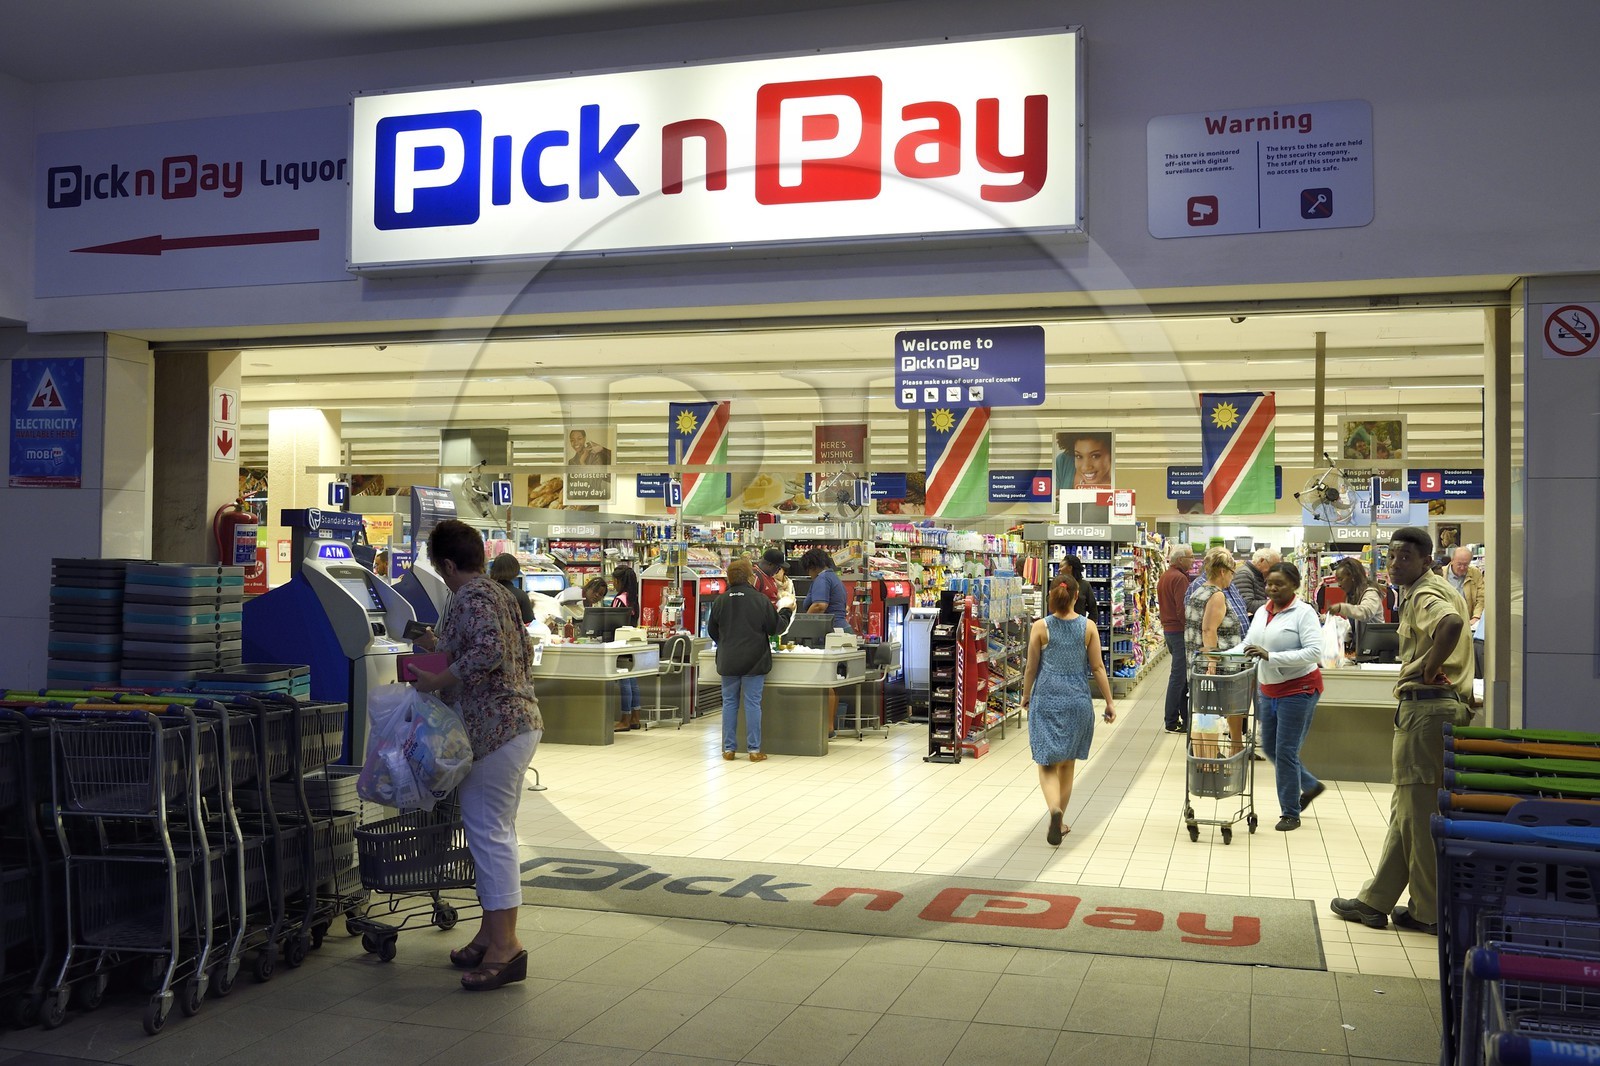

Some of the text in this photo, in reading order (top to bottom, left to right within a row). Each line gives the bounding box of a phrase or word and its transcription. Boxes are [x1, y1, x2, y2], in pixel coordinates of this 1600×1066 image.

[1205, 111, 1312, 135] Warning
[374, 75, 1048, 231] Pick n Pay
[1289, 151, 1316, 159] security
[1208, 157, 1228, 166] digital
[1165, 167, 1204, 175] surveillance
[48, 155, 346, 208] Pick n Pay Liquor
[902, 338, 993, 352] Welcome to
[902, 355, 979, 371] Pick n Pay
[16, 418, 77, 429] ELECTRICITY
[569, 481, 590, 489] value,
[1038, 481, 1046, 492] 3
[1426, 477, 1434, 488] 5
[339, 489, 343, 499] 1
[504, 487, 509, 499] 2
[569, 489, 606, 497] every day!
[674, 489, 679, 500] 3
[864, 488, 868, 499] 4
[322, 516, 346, 525] Standard
[552, 526, 570, 534] Pick
[577, 525, 595, 535] Pay
[789, 526, 808, 535] Pick
[816, 526, 835, 537] Pay
[1054, 526, 1074, 537] Pick
[1084, 526, 1105, 538] Pay
[1338, 529, 1362, 538] Pick
[326, 548, 344, 557] ATM
[520, 855, 1261, 947] Pick n Pay
[1584, 966, 1600, 976] Fr
